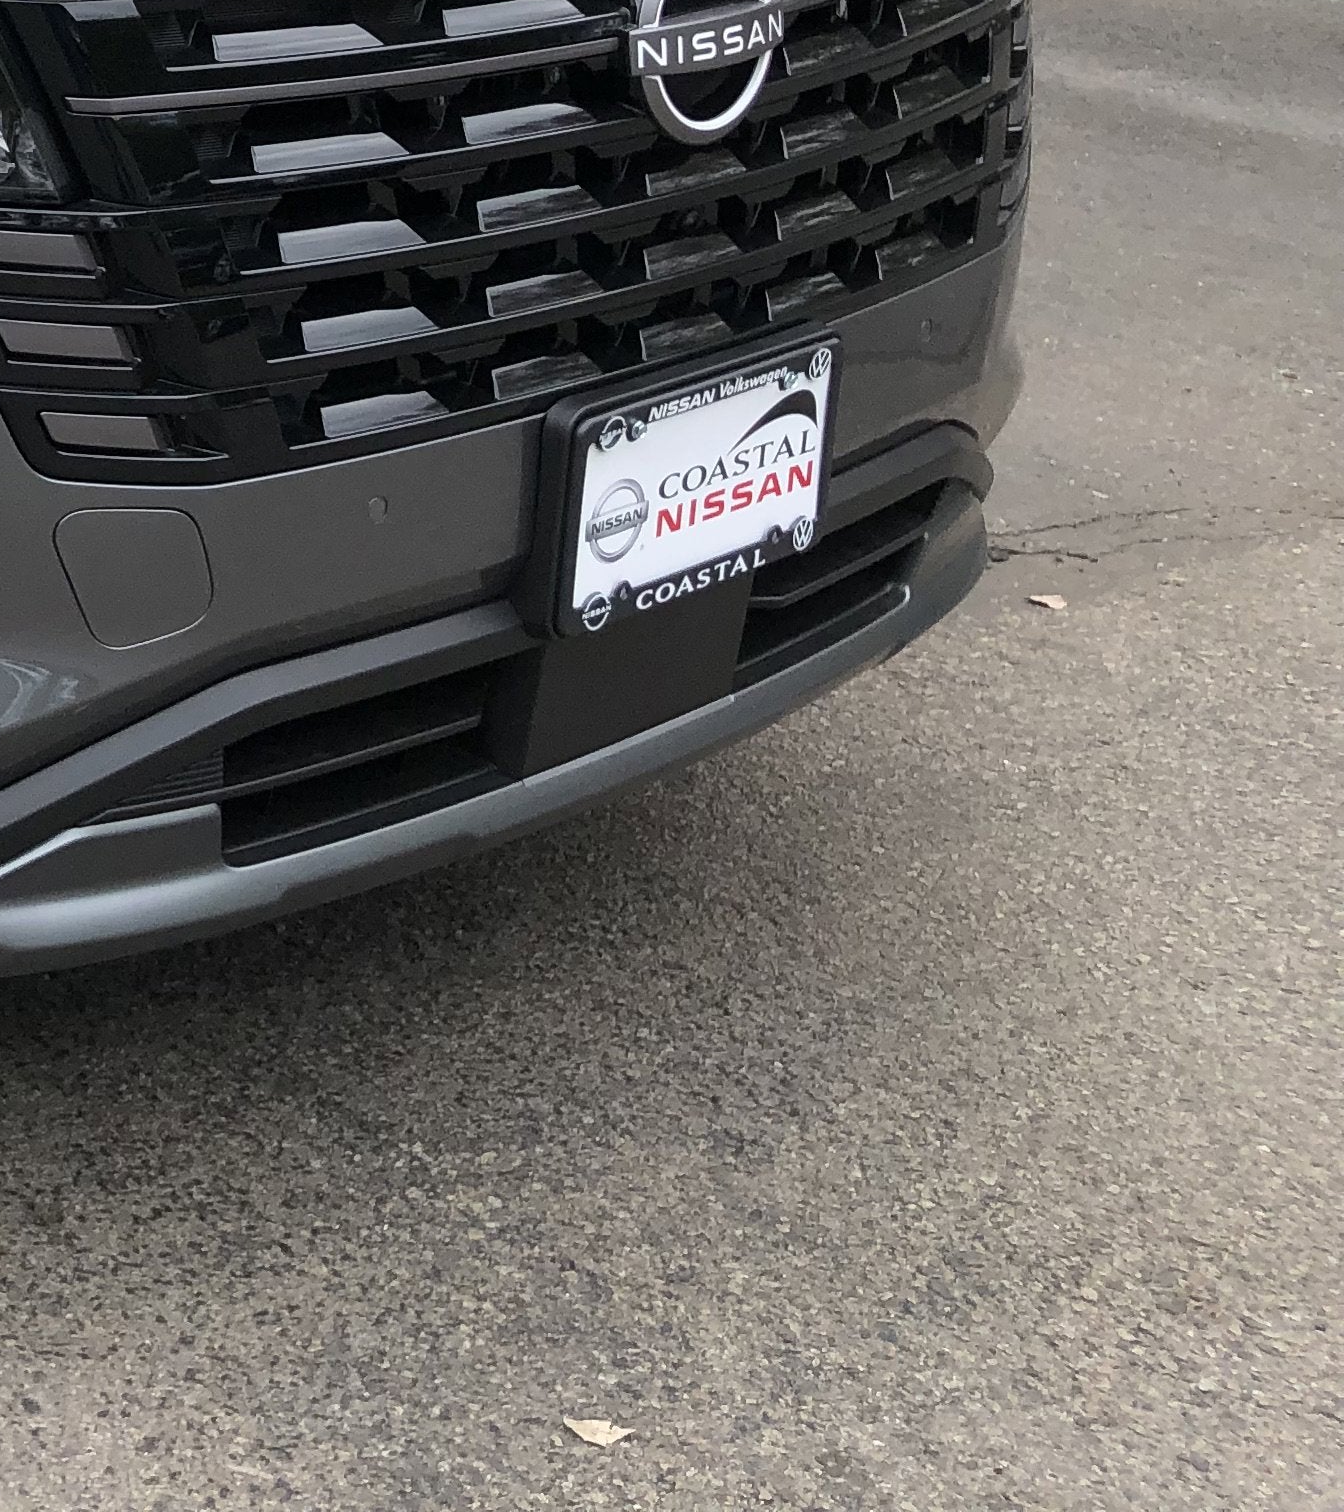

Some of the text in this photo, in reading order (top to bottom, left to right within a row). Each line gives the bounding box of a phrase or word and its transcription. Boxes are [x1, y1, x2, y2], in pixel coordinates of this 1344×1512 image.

[636, 9, 784, 69] NISSAN
[647, 365, 788, 422] NISSAN Volkswagen
[658, 430, 816, 500] COASTAL
[590, 507, 643, 536] NISSAN
[655, 459, 814, 538] NISSAN
[635, 548, 766, 610] COASTAL
